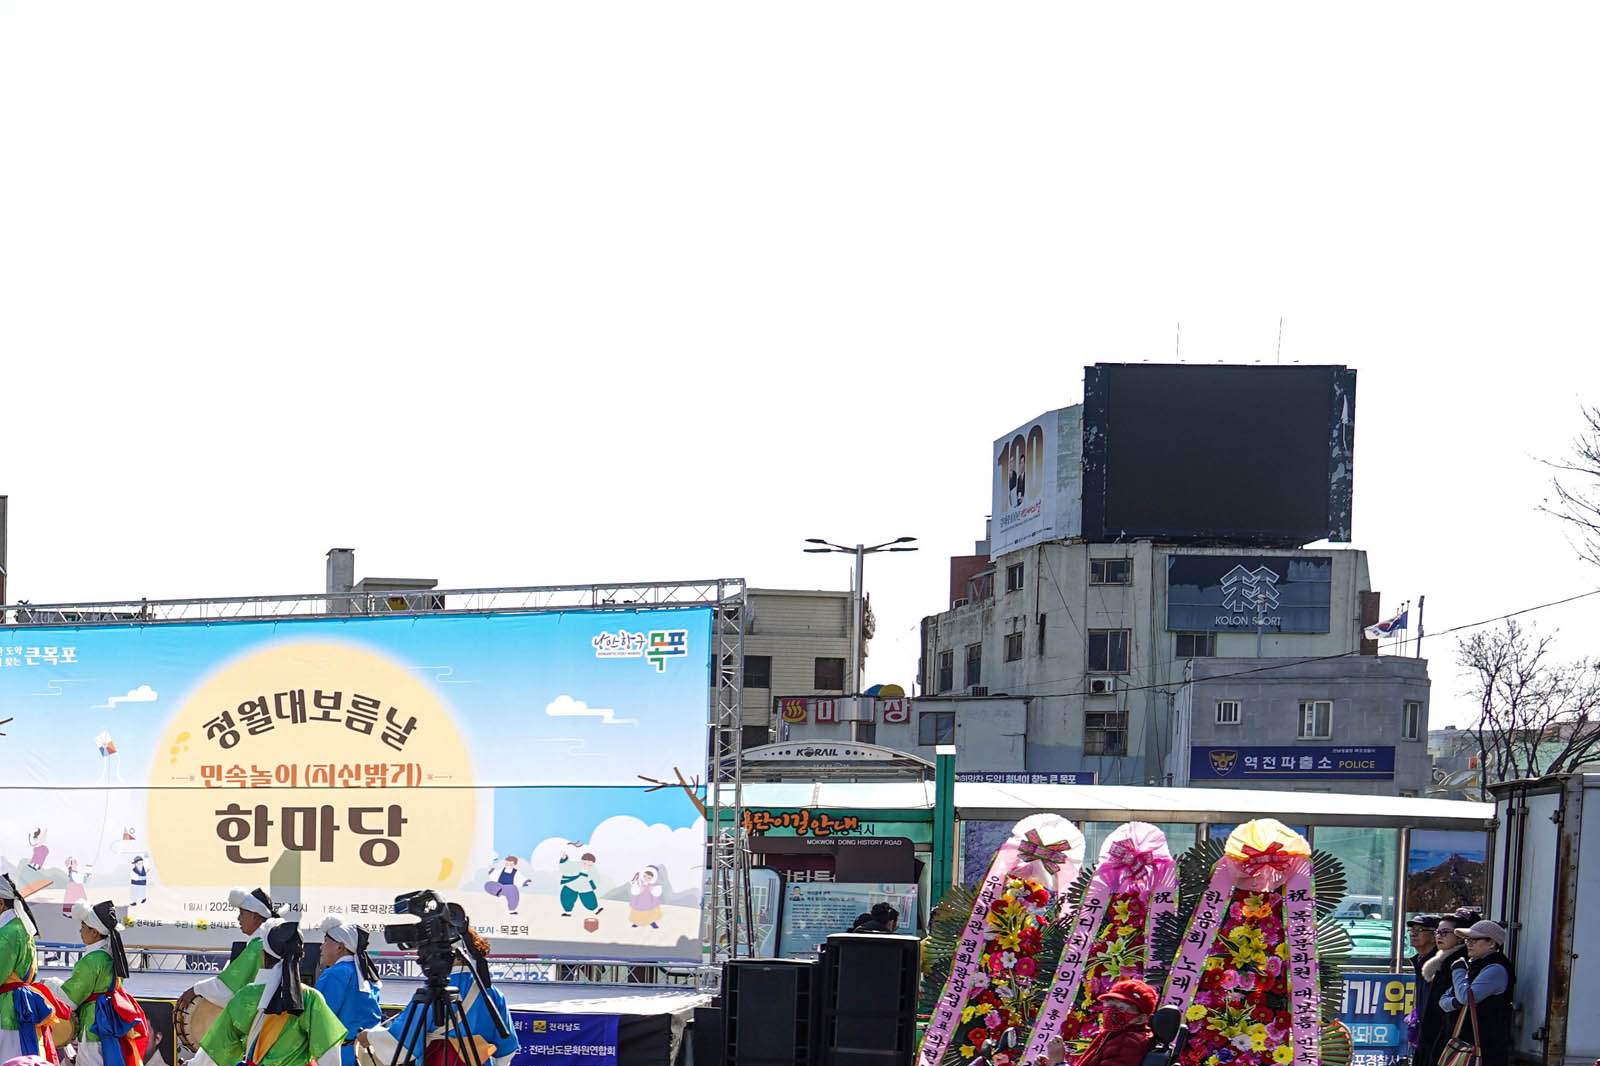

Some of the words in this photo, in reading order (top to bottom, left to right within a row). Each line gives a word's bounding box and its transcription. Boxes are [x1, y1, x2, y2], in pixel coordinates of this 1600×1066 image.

[1215, 616, 1248, 625] KOLON
[647, 632, 685, 671] 목포
[202, 689, 417, 752] 정월대보름날
[796, 747, 838, 757] KORAIL
[1244, 756, 1332, 770] 역전파출소
[1338, 760, 1376, 769] POLICE
[200, 763, 297, 788] 민속놀이
[215, 803, 408, 867] 한마당
[857, 839, 882, 847] HISTORY
[884, 839, 902, 847] ROAD
[1154, 891, 1174, 904] 祝
[1287, 888, 1310, 902] 祝
[500, 925, 529, 935] 목포역
[549, 1022, 581, 1031] 전라남도
[529, 1045, 616, 1057] 전라남도문화원연합회
